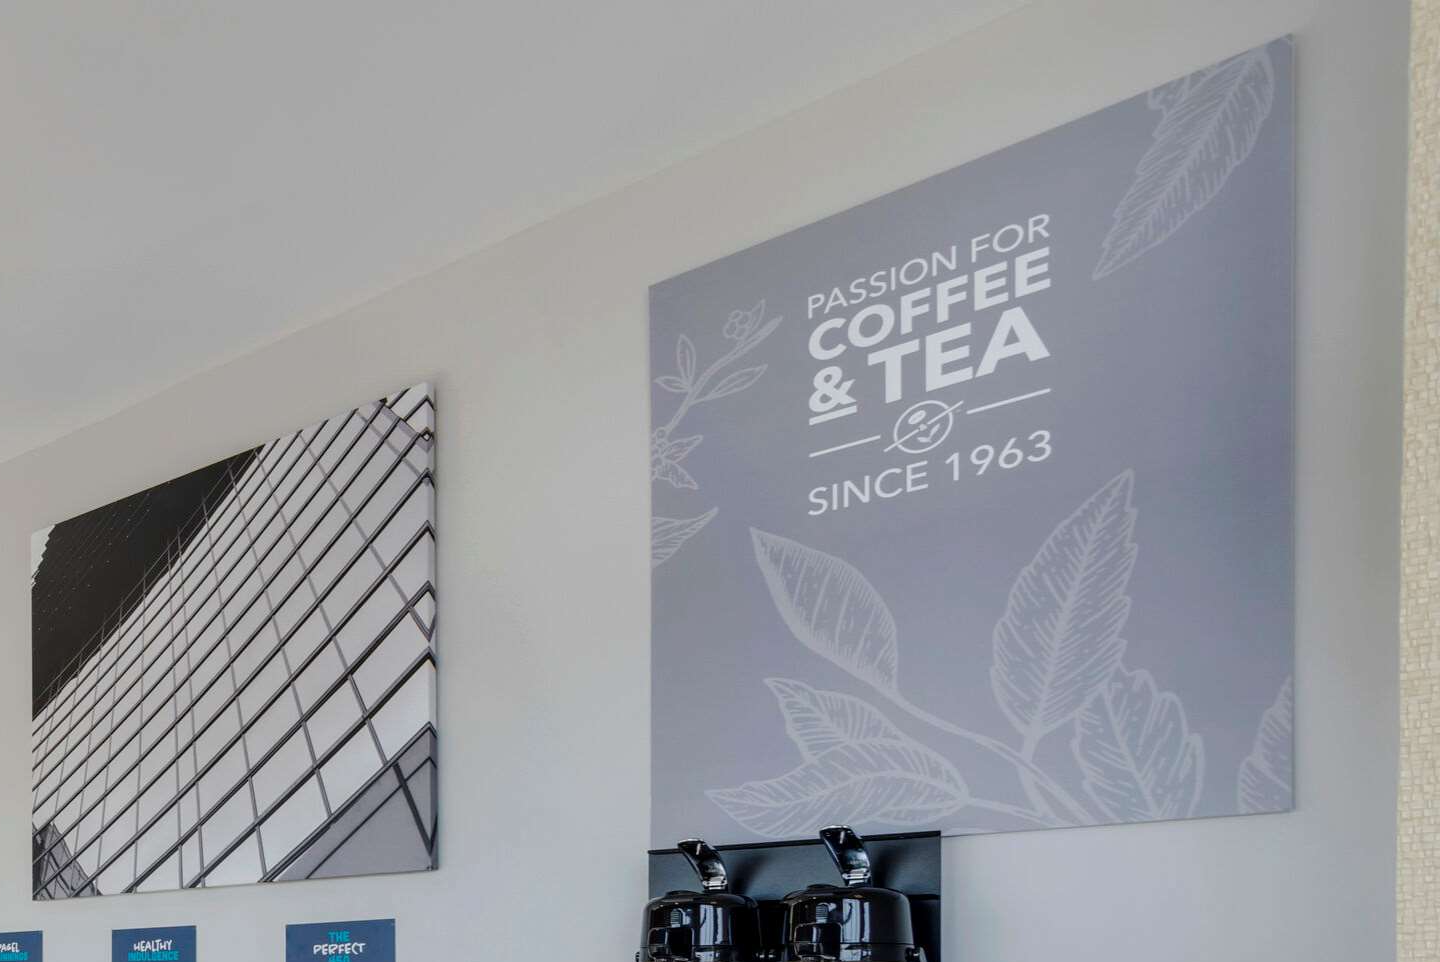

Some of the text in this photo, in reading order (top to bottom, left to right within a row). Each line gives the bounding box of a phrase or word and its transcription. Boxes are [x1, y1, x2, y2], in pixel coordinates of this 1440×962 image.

[807, 213, 1051, 319] PASSION FOR
[808, 246, 1051, 361] COFFEE
[808, 306, 1051, 413] & TEA
[808, 430, 1052, 516] SINCE 1963
[133, 939, 173, 952] HEALTHY
[313, 942, 366, 955] PERFECT
[327, 930, 350, 942] THE
